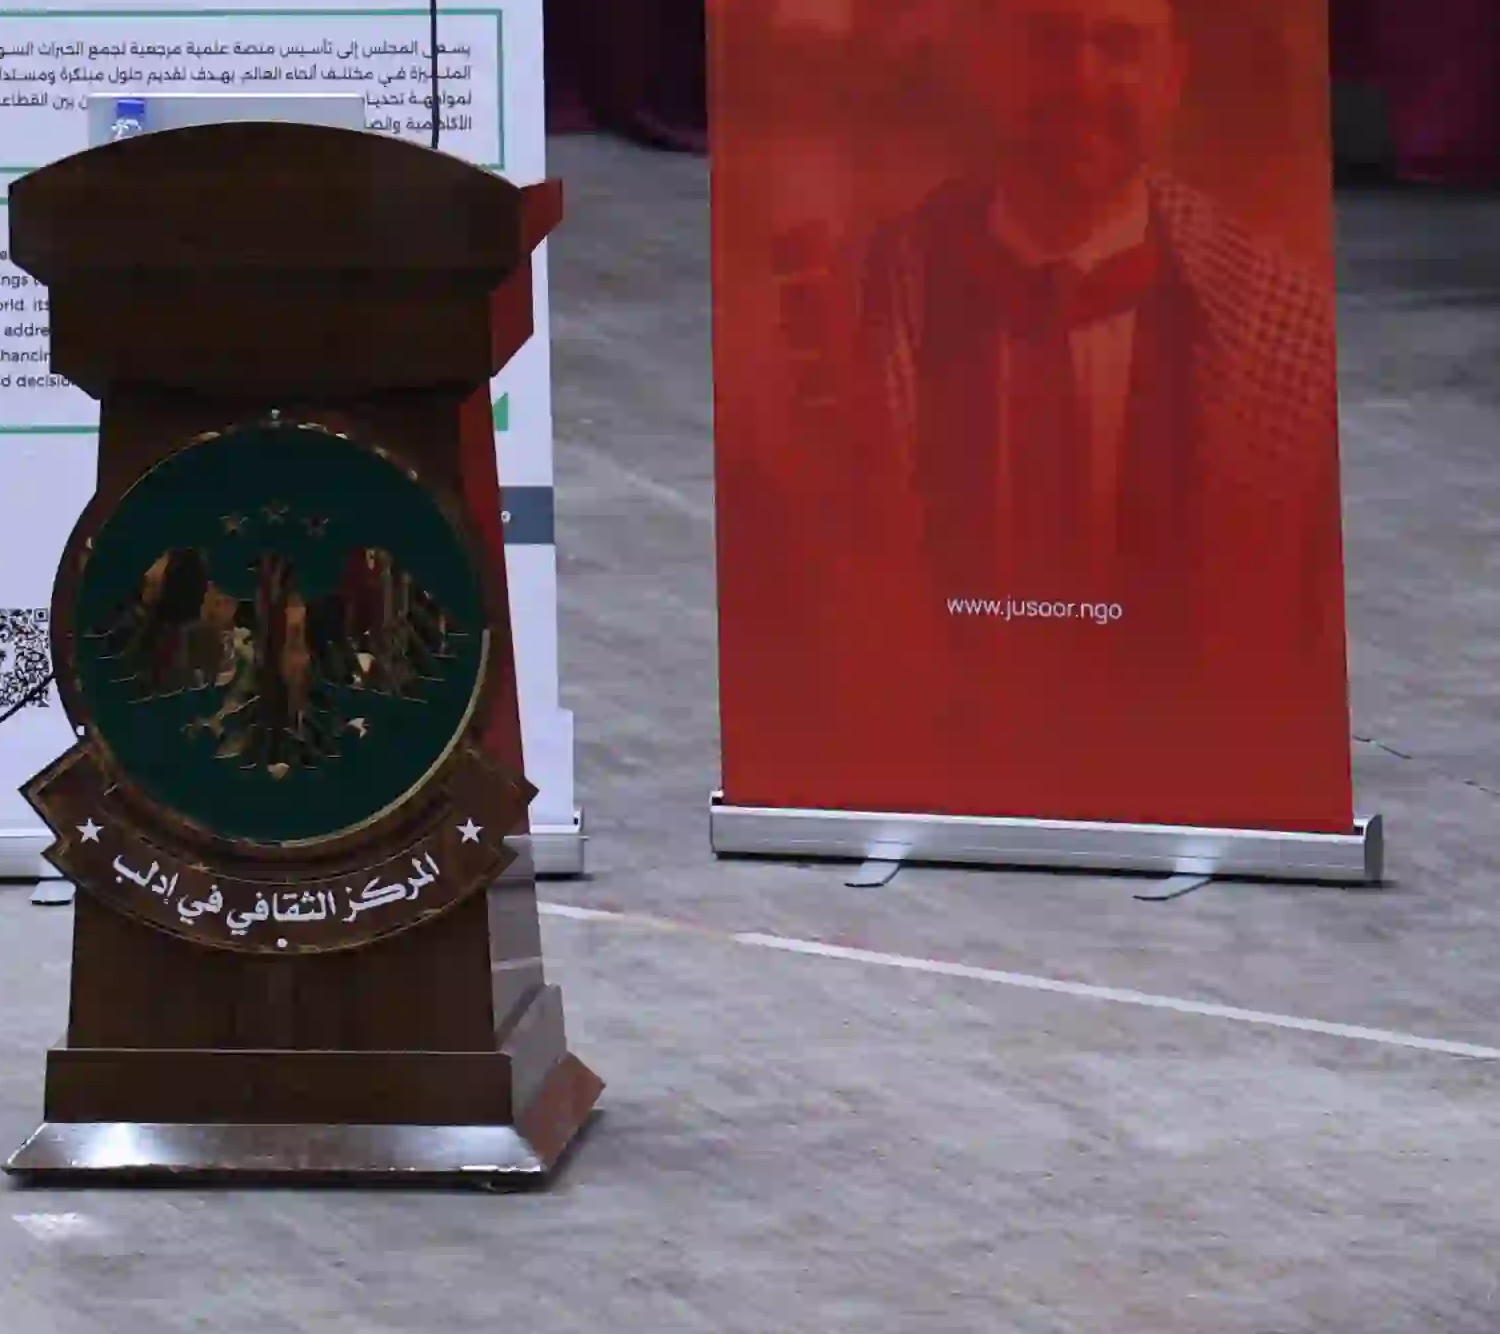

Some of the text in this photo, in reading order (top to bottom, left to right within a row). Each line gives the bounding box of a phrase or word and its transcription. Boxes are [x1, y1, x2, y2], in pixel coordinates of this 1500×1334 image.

[410, 65, 471, 83] المتيزة
[363, 90, 405, 108] تحديا
[409, 89, 472, 109] لمواهة
[4, 322, 50, 337] addre
[16, 374, 71, 388] decisio
[947, 593, 1123, 625] www.jusoor.ngo
[112, 852, 441, 938] المركز الثقافي في إدلب
